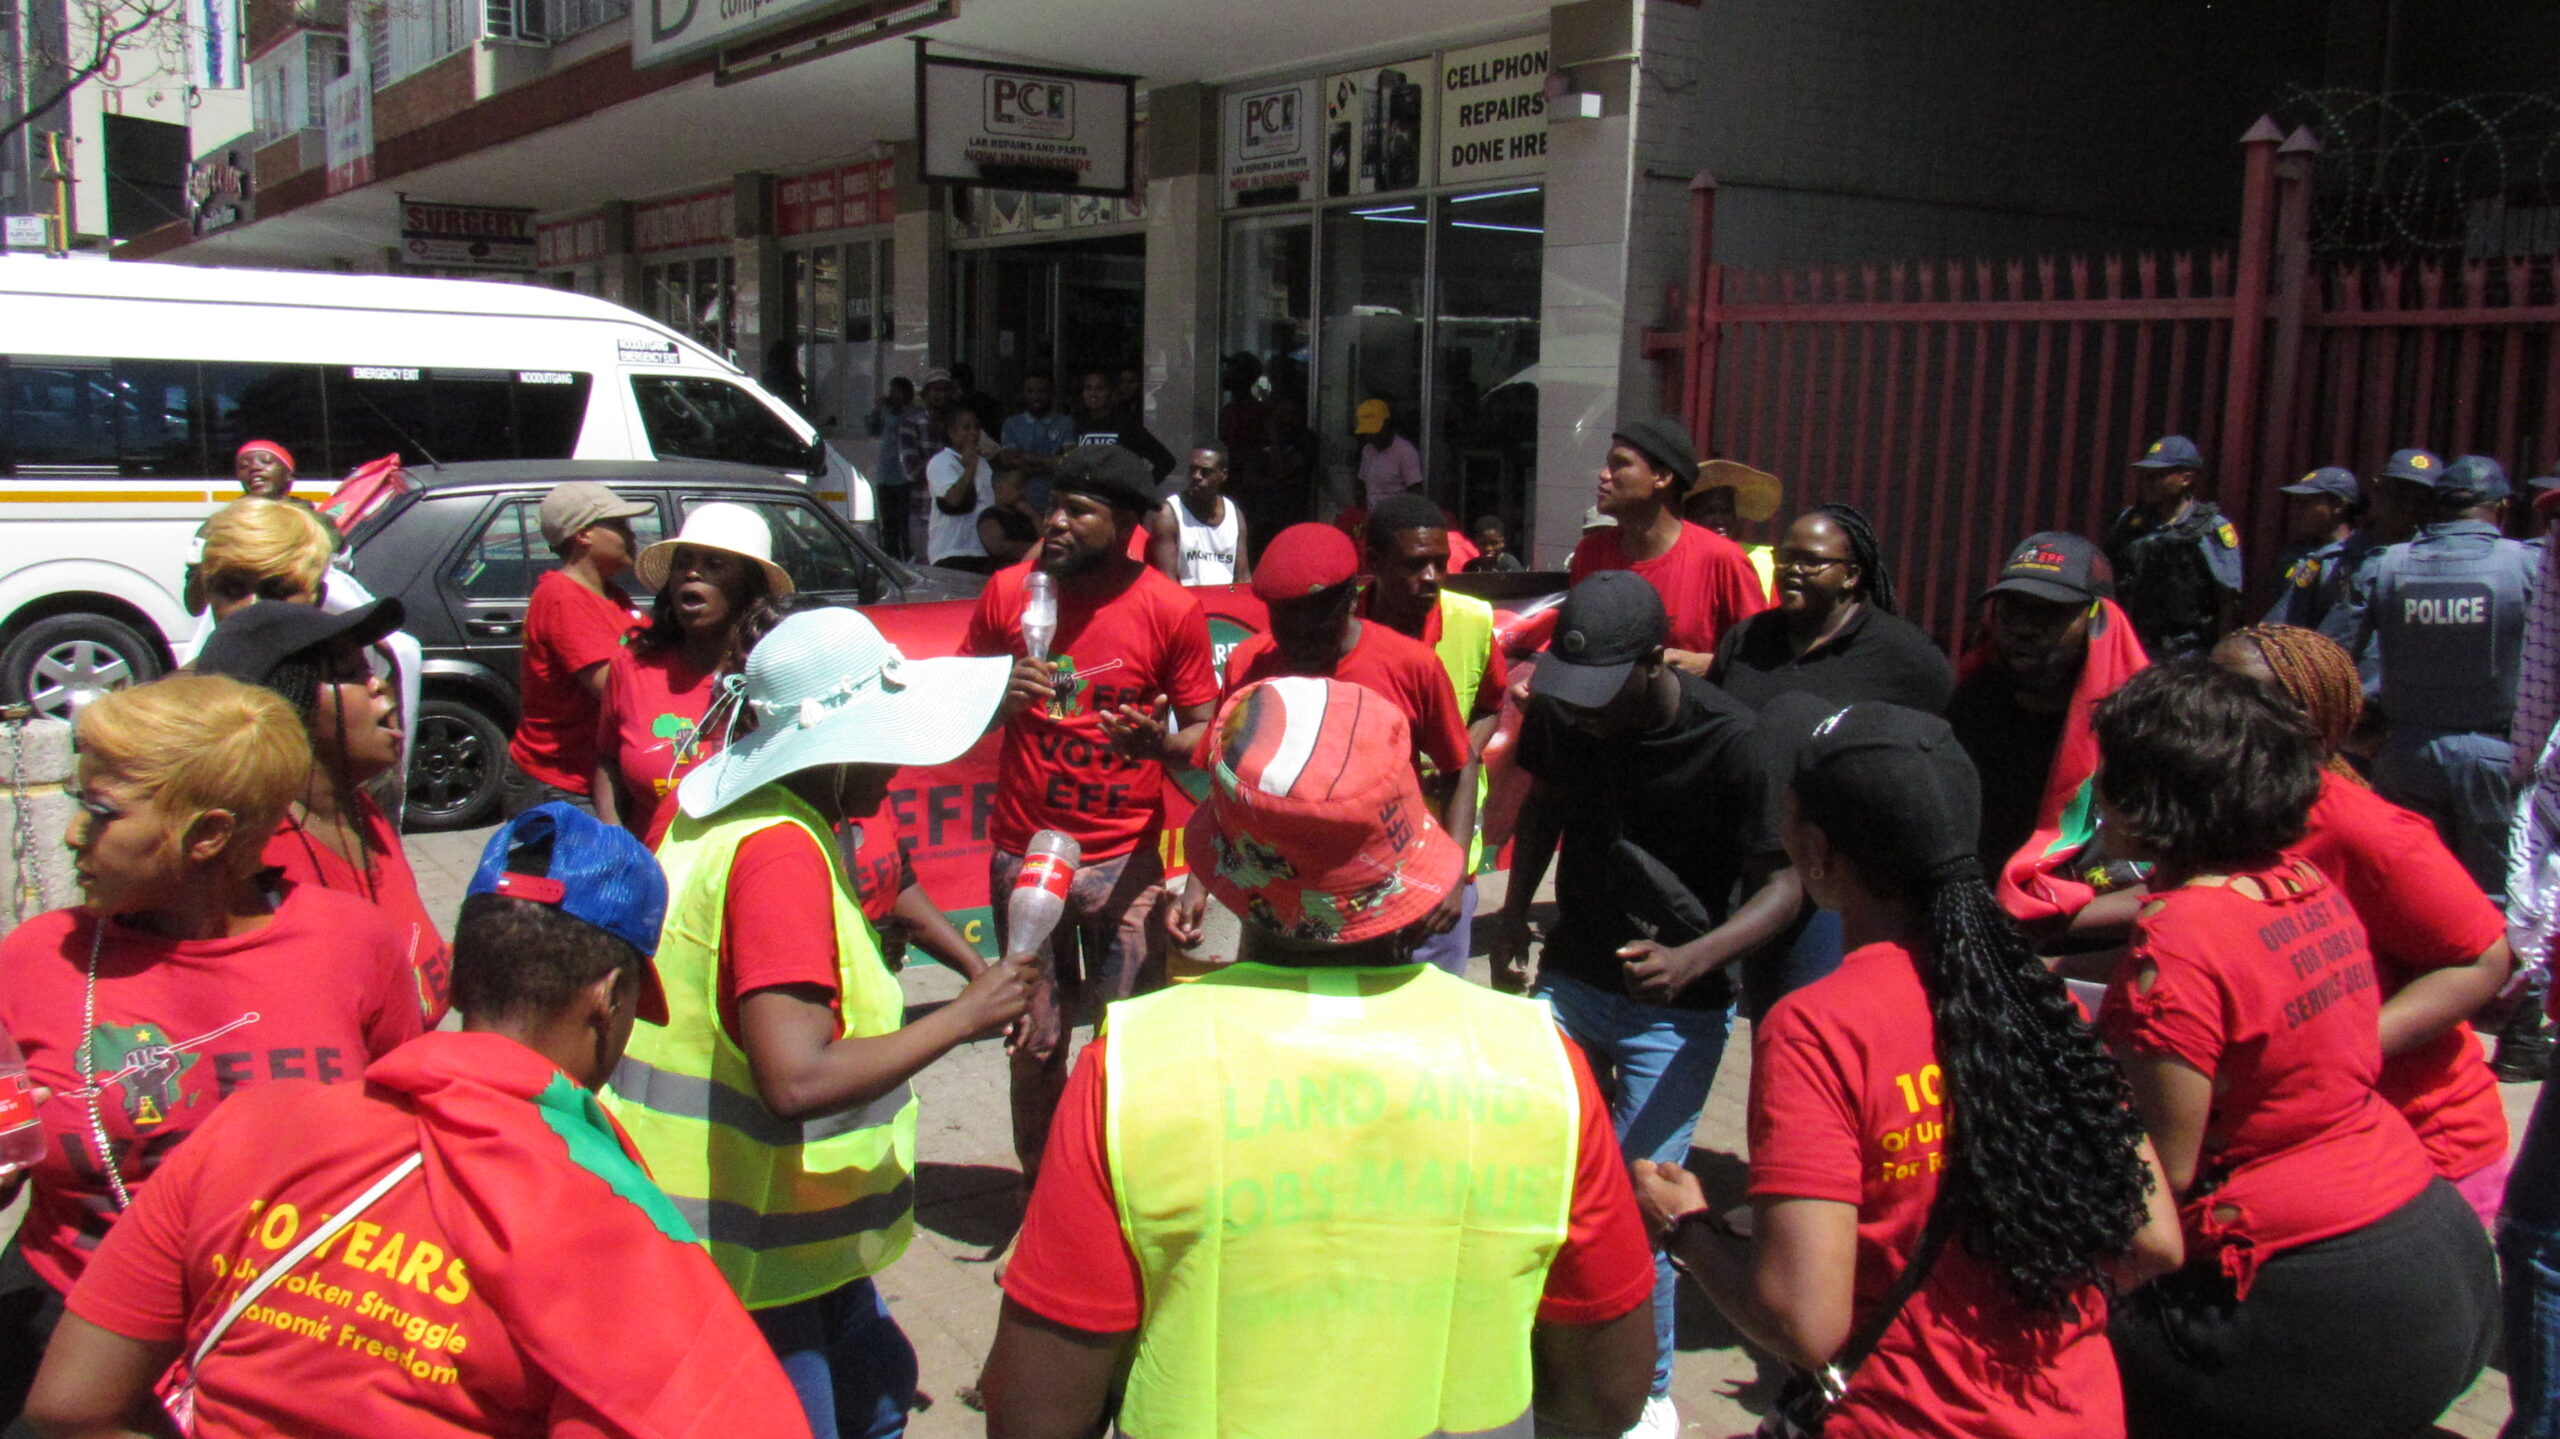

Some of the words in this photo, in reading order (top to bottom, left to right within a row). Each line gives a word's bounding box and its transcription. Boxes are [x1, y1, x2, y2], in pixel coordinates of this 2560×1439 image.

[1446, 50, 1548, 91] CELLPHON
[1460, 90, 1545, 127] REPAIRS
[990, 139, 1032, 151] REPAIRS
[1036, 142, 1056, 153] AND
[1058, 143, 1088, 155] PARTS
[1452, 138, 1504, 167] DONE
[407, 206, 529, 238] SURGERY
[353, 367, 401, 380] EMERGENCY
[404, 368, 420, 381] EXIT
[2405, 596, 2485, 624] POLICE
[1037, 732, 1142, 771] VOT
[1046, 773, 1129, 815] EFF
[889, 782, 998, 850] EFF
[2259, 916, 2300, 952] OUR
[2297, 901, 2334, 933] LAST
[2291, 946, 2323, 980] FOR
[2320, 930, 2354, 964] JOBS
[1224, 1070, 1387, 1142] LAND
[1405, 1069, 1530, 1126] AND
[1895, 1064, 1943, 1114] 10
[1881, 1127, 1911, 1152] Of
[1883, 1162, 1921, 1182] For
[313, 1213, 471, 1305] YEARS
[234, 1257, 353, 1309] Unroken
[356, 1290, 468, 1354] Struggle
[231, 1290, 332, 1342] onomic
[337, 1323, 459, 1384] Freedom
